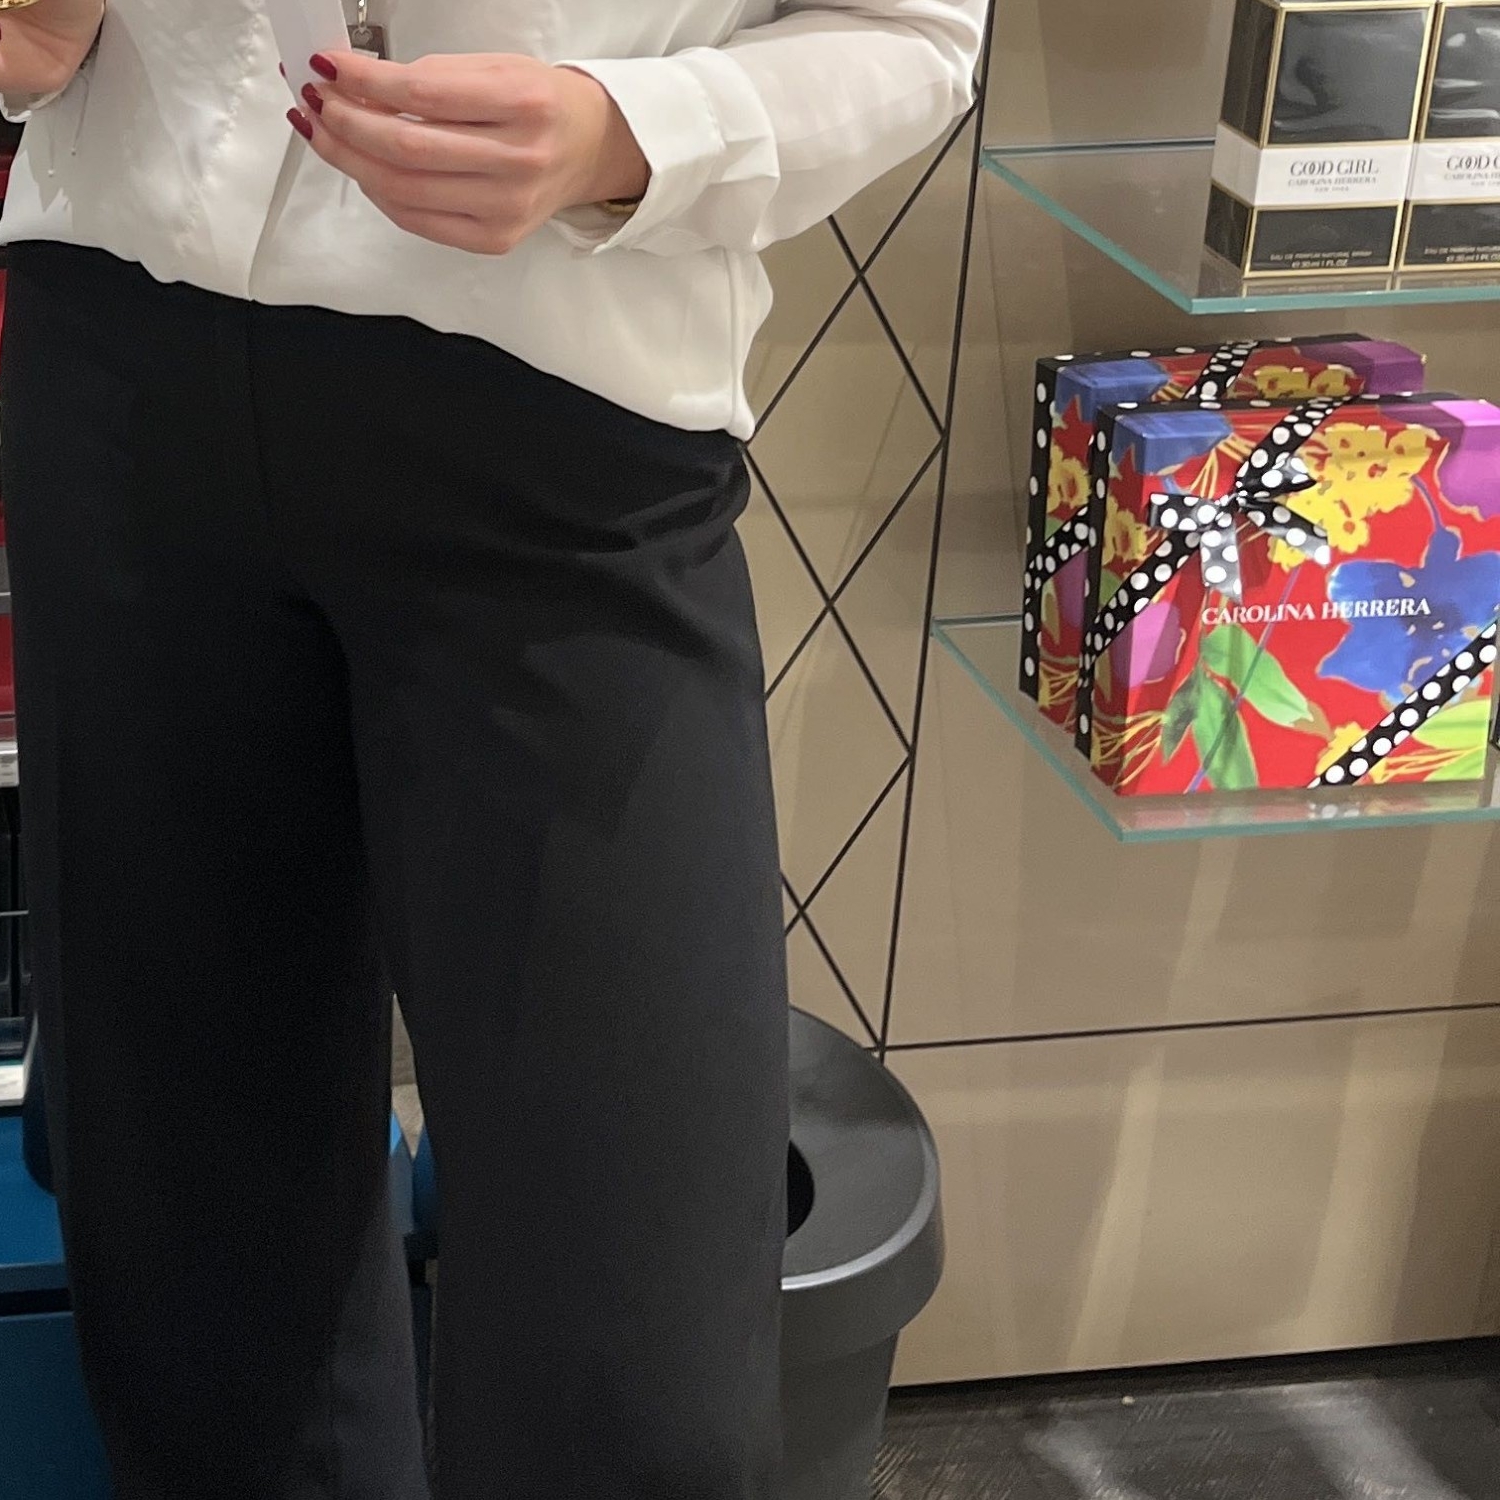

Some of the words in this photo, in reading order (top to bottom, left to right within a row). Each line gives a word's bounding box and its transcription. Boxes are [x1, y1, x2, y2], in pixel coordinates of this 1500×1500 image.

[1290, 160, 1334, 177] GOOD
[1337, 158, 1379, 175] GIRL
[1446, 154, 1490, 171] GOOD
[1288, 178, 1332, 187] CAROLINA
[1334, 177, 1376, 185] HERRERA
[1201, 600, 1315, 626] CAROLINA
[1321, 597, 1431, 620] HERRERA
